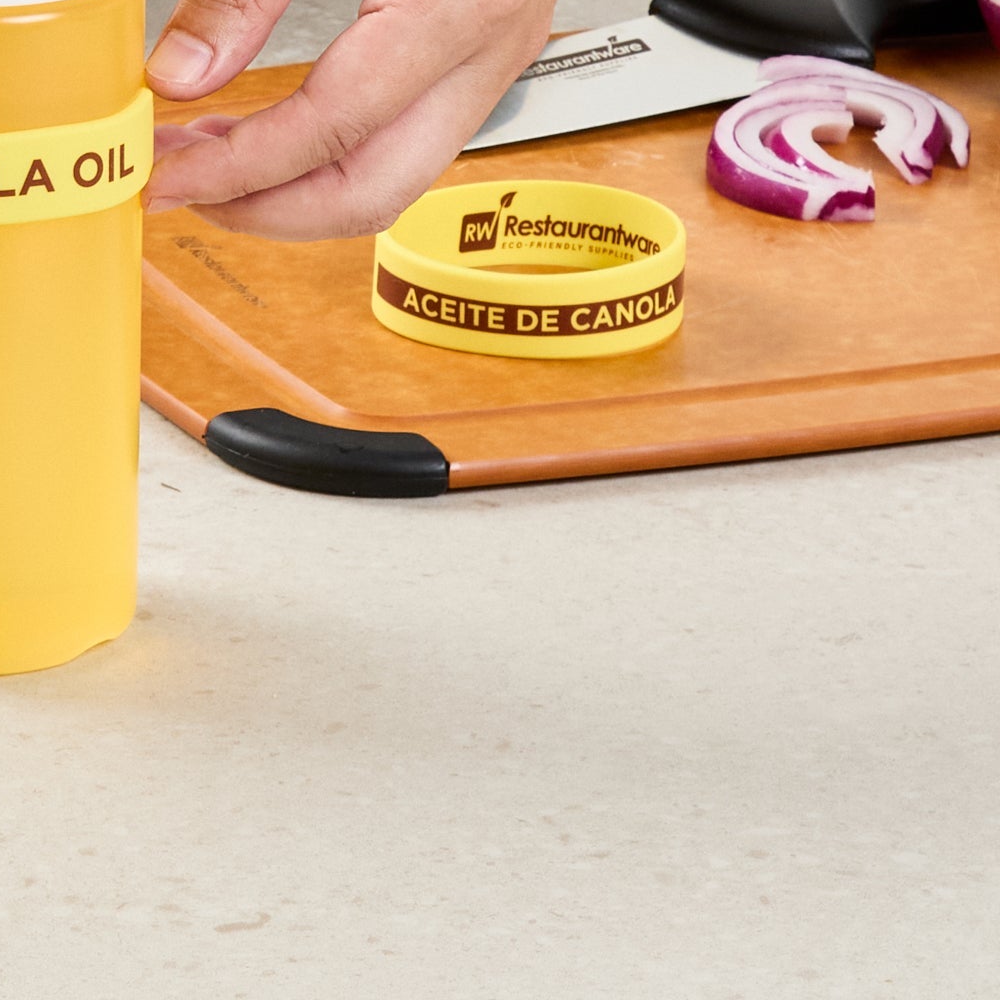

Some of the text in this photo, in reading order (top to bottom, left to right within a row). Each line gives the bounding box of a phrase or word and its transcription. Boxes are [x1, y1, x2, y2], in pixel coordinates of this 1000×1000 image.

[521, 42, 643, 78] estaurantware
[73, 143, 135, 188] OIL
[464, 219, 495, 243] RW
[503, 214, 661, 256] Restaurantware
[501, 241, 634, 262] ECO-FRIENDLY SUPPLIES
[402, 284, 677, 333] ACEITE DE CANOLA
